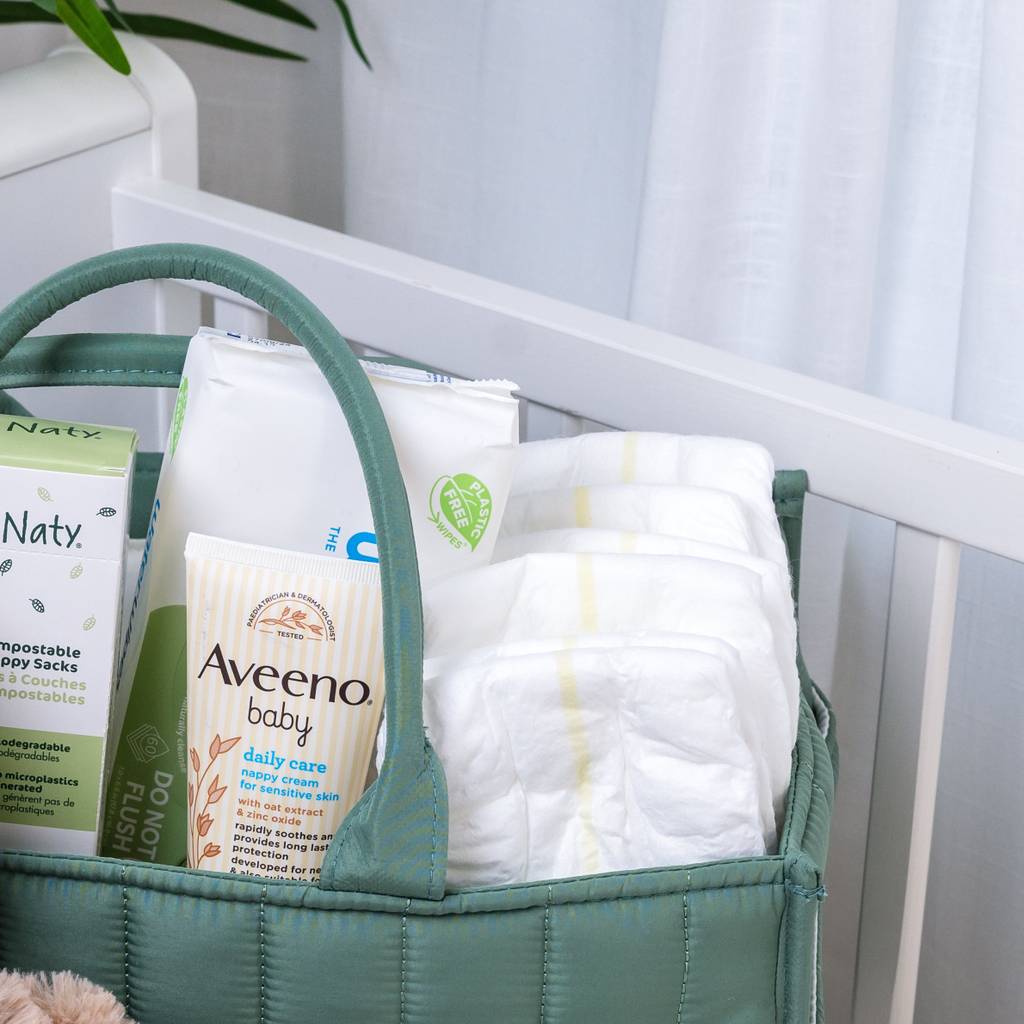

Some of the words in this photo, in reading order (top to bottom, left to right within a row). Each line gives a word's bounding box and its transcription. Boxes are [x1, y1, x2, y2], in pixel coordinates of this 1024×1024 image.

[7, 421, 100, 439] Naty
[444, 488, 469, 528] FREE
[470, 481, 490, 539] PLASTIC
[2, 510, 82, 549] Naty
[325, 526, 341, 552] THE
[436, 521, 463, 549] WIPES
[247, 592, 289, 627] PAEDIATRICIAN
[298, 592, 335, 642] DERMATOLOGIST
[277, 630, 304, 640] TESTED
[33, 659, 79, 673] Sacks
[197, 642, 371, 706] Aveeno
[9, 671, 17, 684] à
[21, 674, 87, 691] Couches
[248, 696, 313, 747] baby
[145, 736, 158, 755] 60
[243, 747, 286, 769] daily
[289, 759, 327, 774] care
[5, 772, 79, 787] microplastics
[150, 770, 174, 806] DO
[241, 768, 278, 783] nappy
[281, 776, 319, 788] cream
[240, 779, 257, 791] for
[260, 785, 313, 800] sensitive
[316, 792, 340, 801] skin
[44, 798, 61, 807] pas
[63, 797, 75, 807] de
[238, 797, 260, 809] with
[264, 802, 281, 812] oat
[284, 806, 324, 817] extract
[112, 780, 146, 853] FLUSH
[236, 808, 243, 816] &
[247, 809, 268, 821] zinc
[271, 815, 302, 826] oxide
[138, 809, 165, 861] NOT
[235, 822, 273, 837] rapidly
[275, 829, 318, 841] soothes
[321, 833, 333, 841] an
[232, 844, 289, 860] protection
[233, 833, 280, 848] provides
[283, 841, 307, 852] long
[231, 856, 287, 873] developed
[291, 865, 306, 874] for
